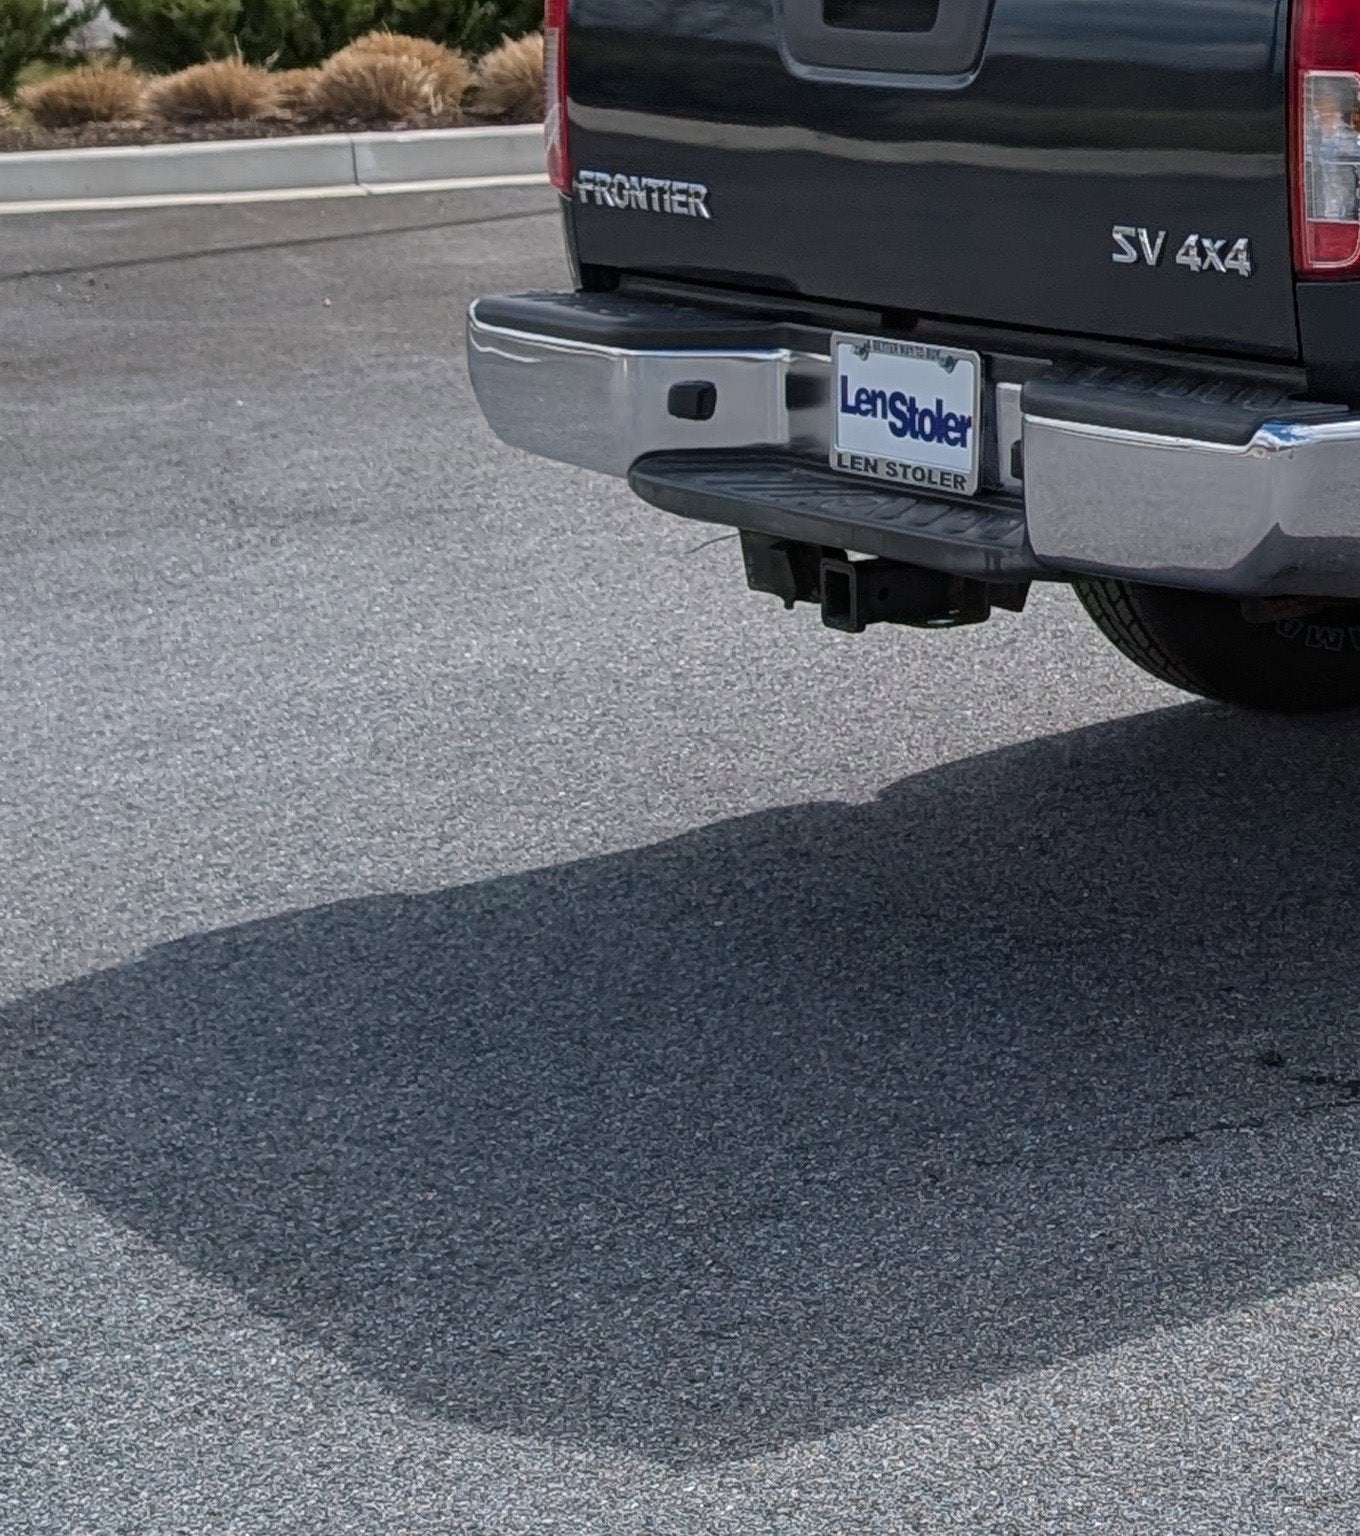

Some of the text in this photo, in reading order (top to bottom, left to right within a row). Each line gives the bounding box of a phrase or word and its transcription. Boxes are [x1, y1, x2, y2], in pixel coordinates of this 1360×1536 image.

[578, 169, 711, 219] FRONTIER
[1112, 225, 1167, 266] SV
[836, 453, 968, 491] LEN STOLER
